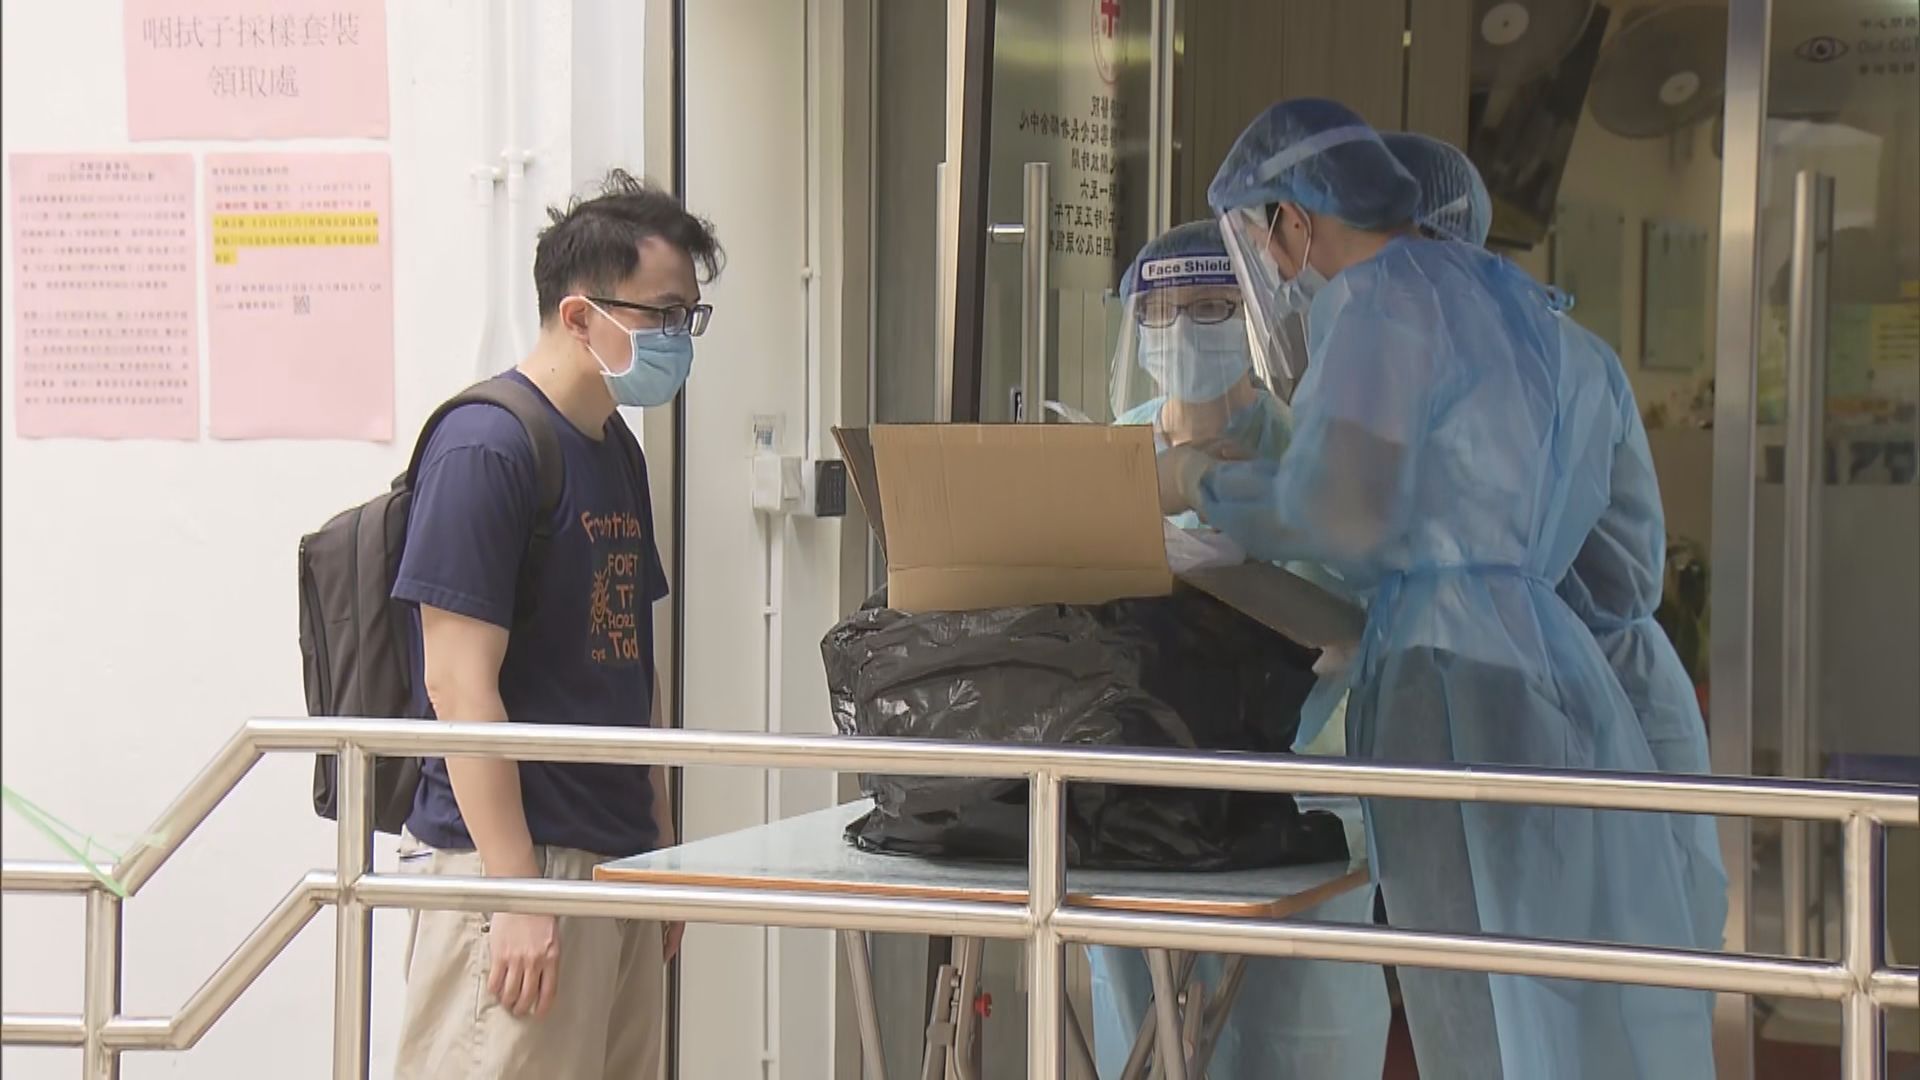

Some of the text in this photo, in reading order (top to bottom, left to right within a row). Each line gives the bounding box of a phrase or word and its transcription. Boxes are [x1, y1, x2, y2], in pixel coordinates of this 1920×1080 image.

[208, 64, 301, 98] 領取處
[1148, 258, 1231, 277] Face Shield
